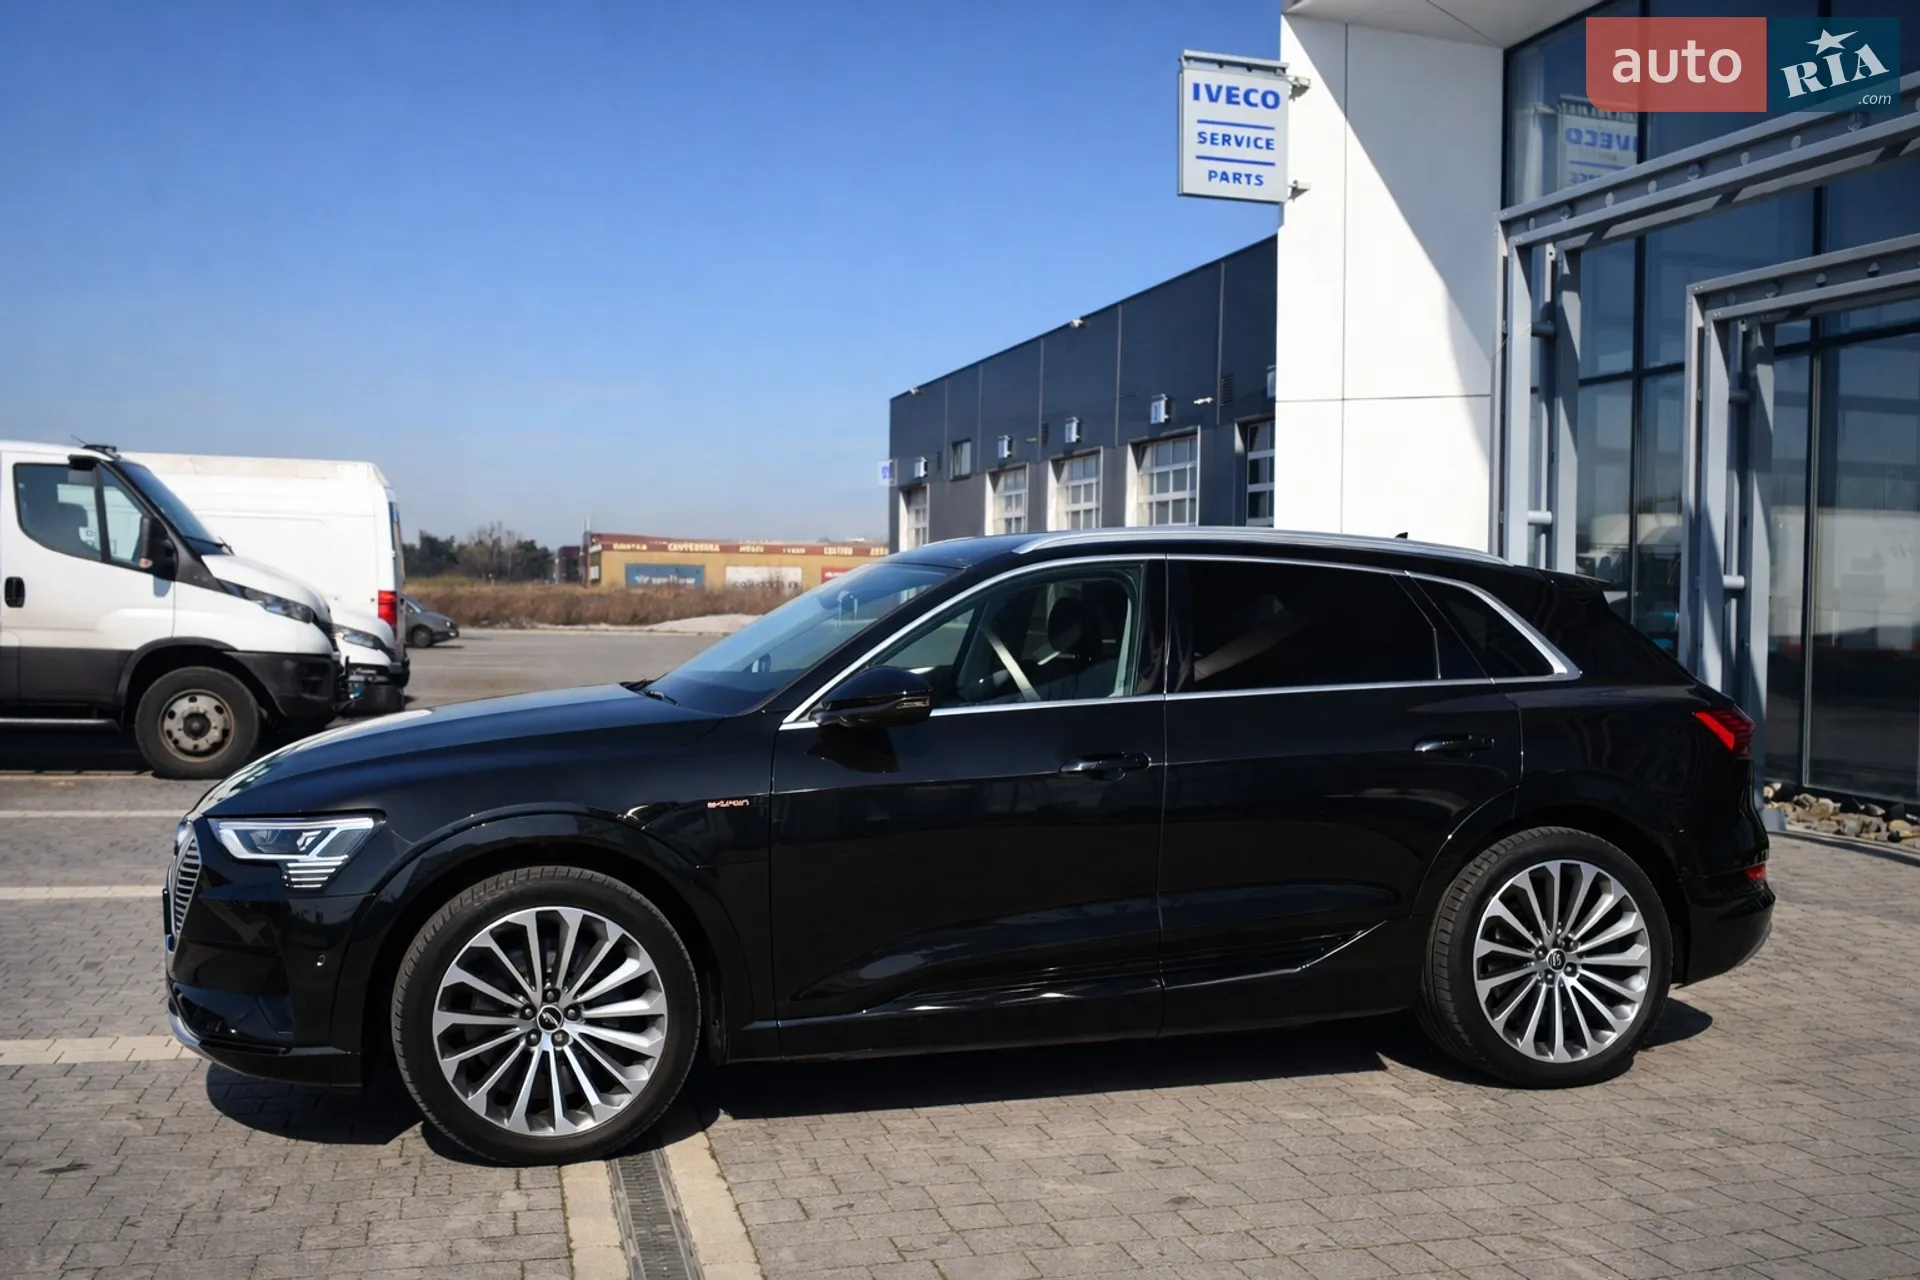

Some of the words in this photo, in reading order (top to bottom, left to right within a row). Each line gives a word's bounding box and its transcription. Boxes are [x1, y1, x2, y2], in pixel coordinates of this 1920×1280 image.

[1192, 82, 1280, 110] IVECO
[1196, 131, 1275, 150] SERVICE
[1208, 169, 1263, 187] PARTS
